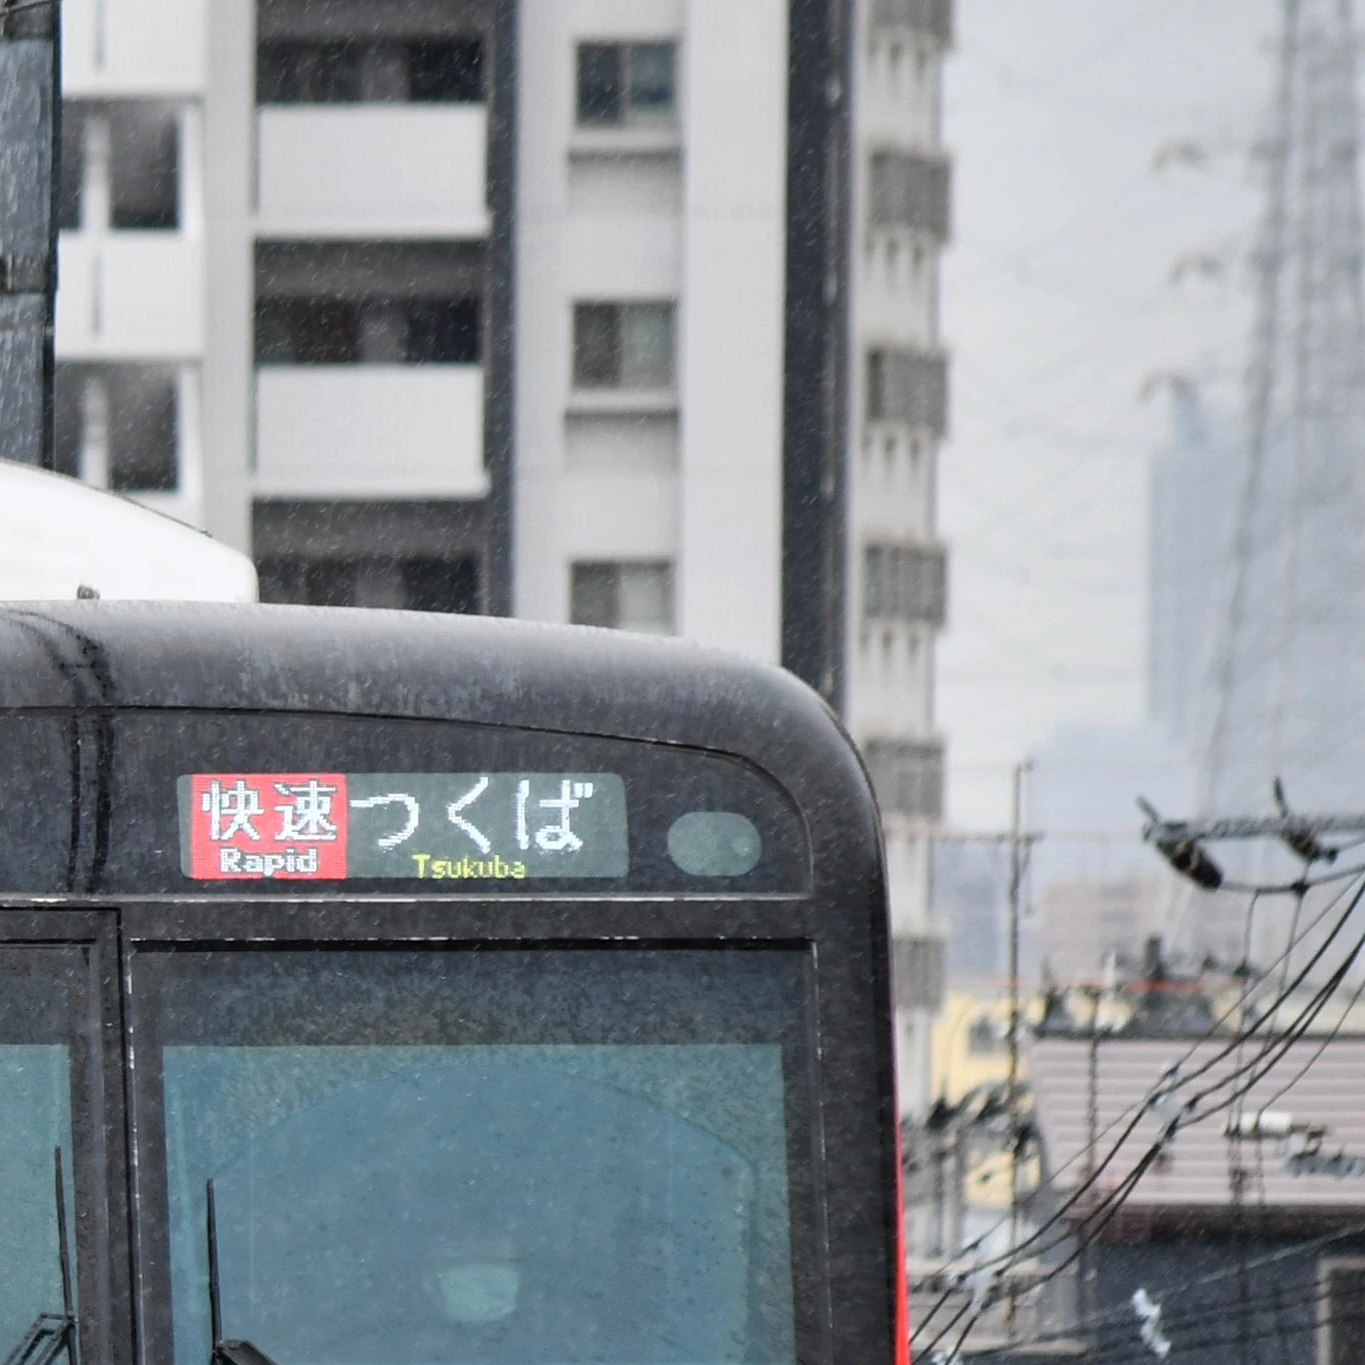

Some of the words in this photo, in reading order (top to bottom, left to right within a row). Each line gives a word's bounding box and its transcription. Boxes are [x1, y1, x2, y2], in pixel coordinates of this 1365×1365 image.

[202, 779, 337, 841] 快速
[350, 776, 594, 854] つくば
[220, 847, 317, 877] Rapid
[411, 853, 527, 880] Tsukuba
